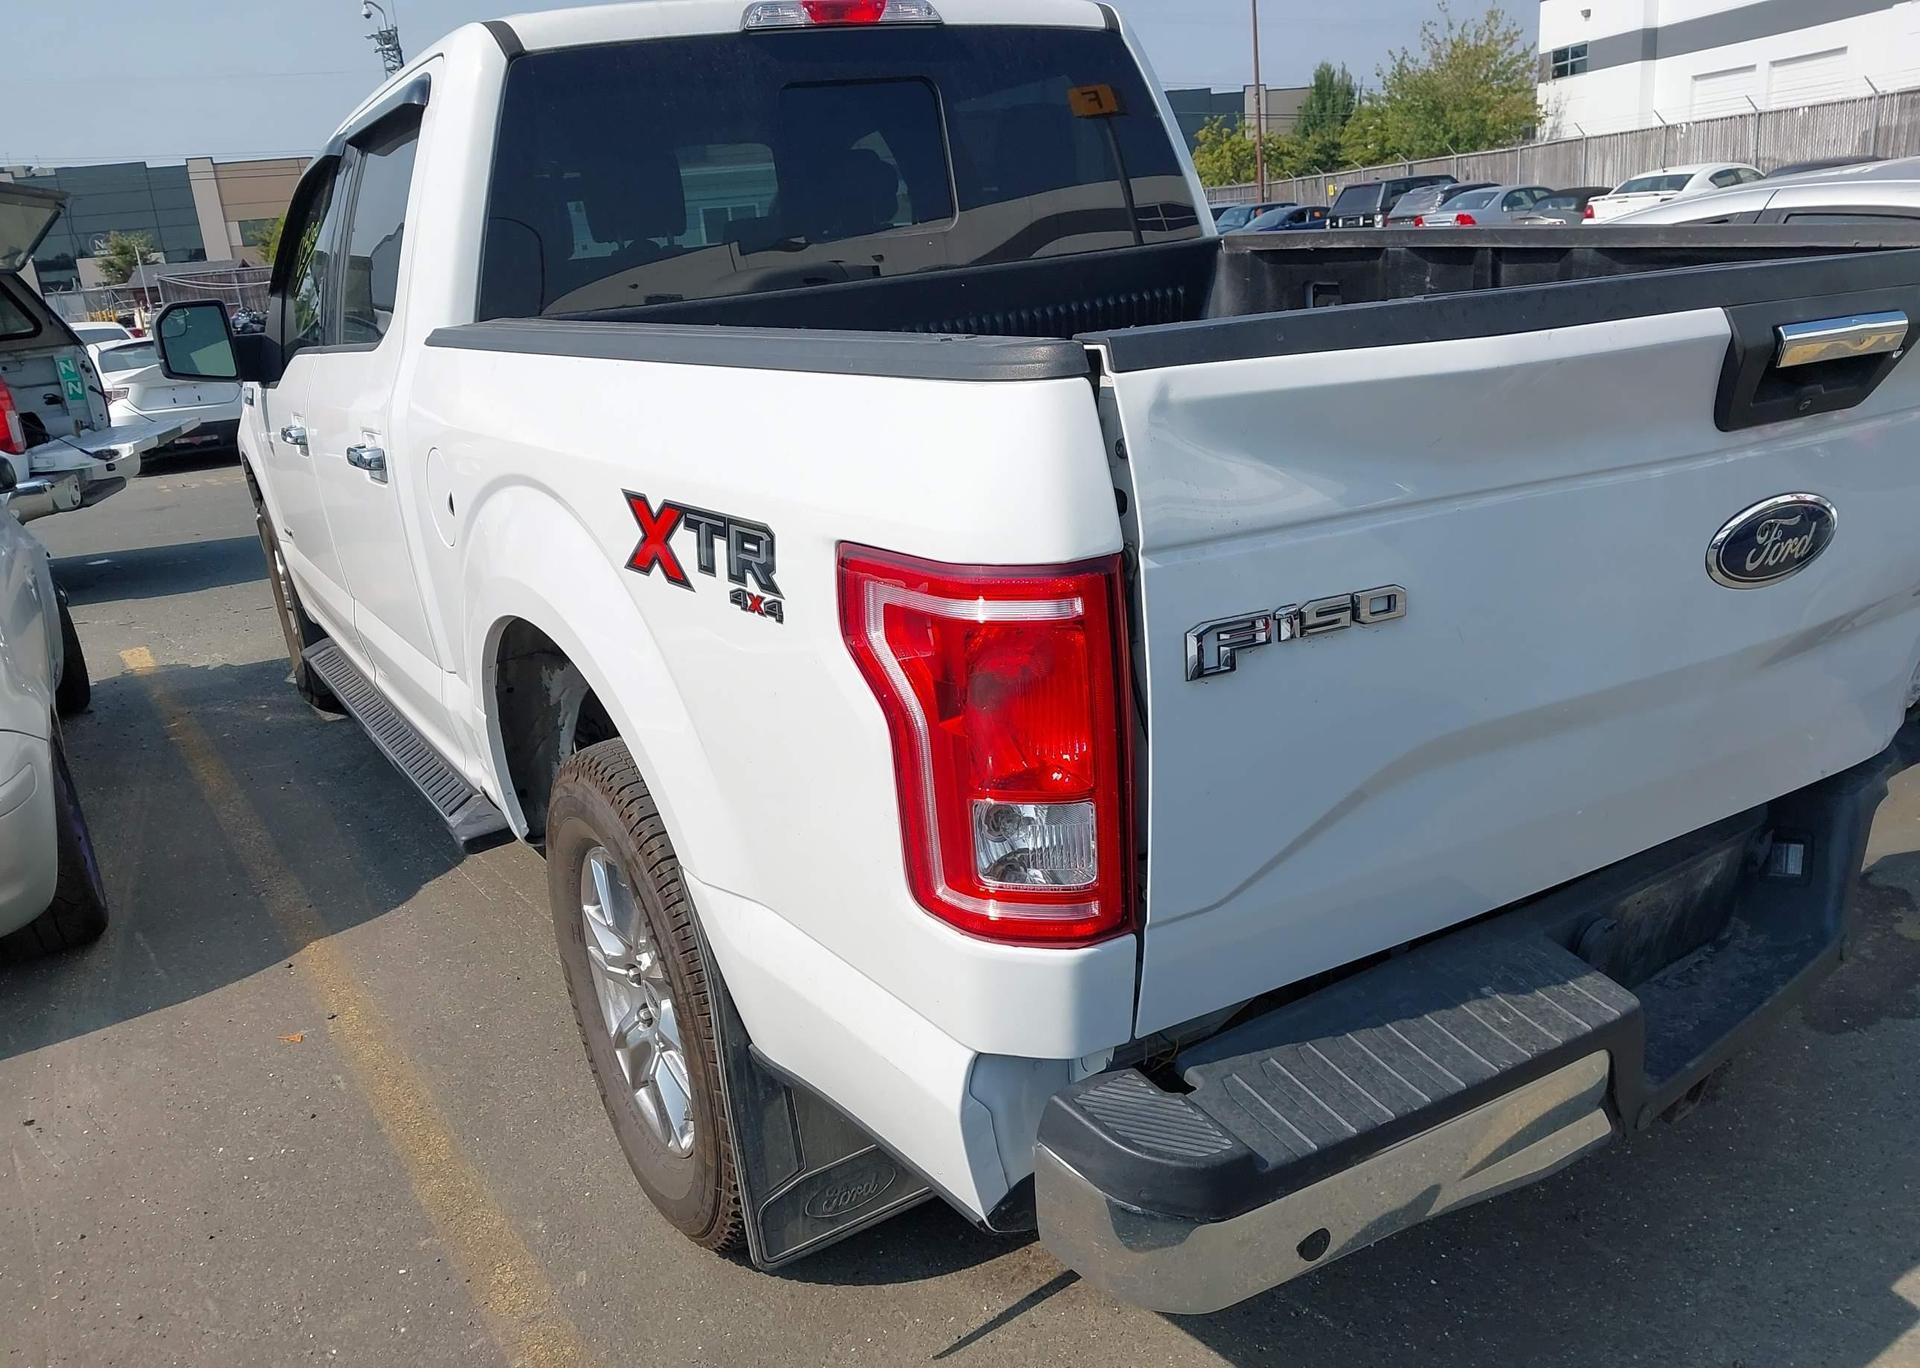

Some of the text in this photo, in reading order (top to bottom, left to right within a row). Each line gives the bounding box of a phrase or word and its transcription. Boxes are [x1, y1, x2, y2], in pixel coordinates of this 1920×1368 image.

[59, 360, 75, 375] N
[67, 381, 83, 395] N
[621, 488, 785, 600] XTR
[1746, 514, 1817, 571] Ford
[823, 1173, 879, 1213] Ford
